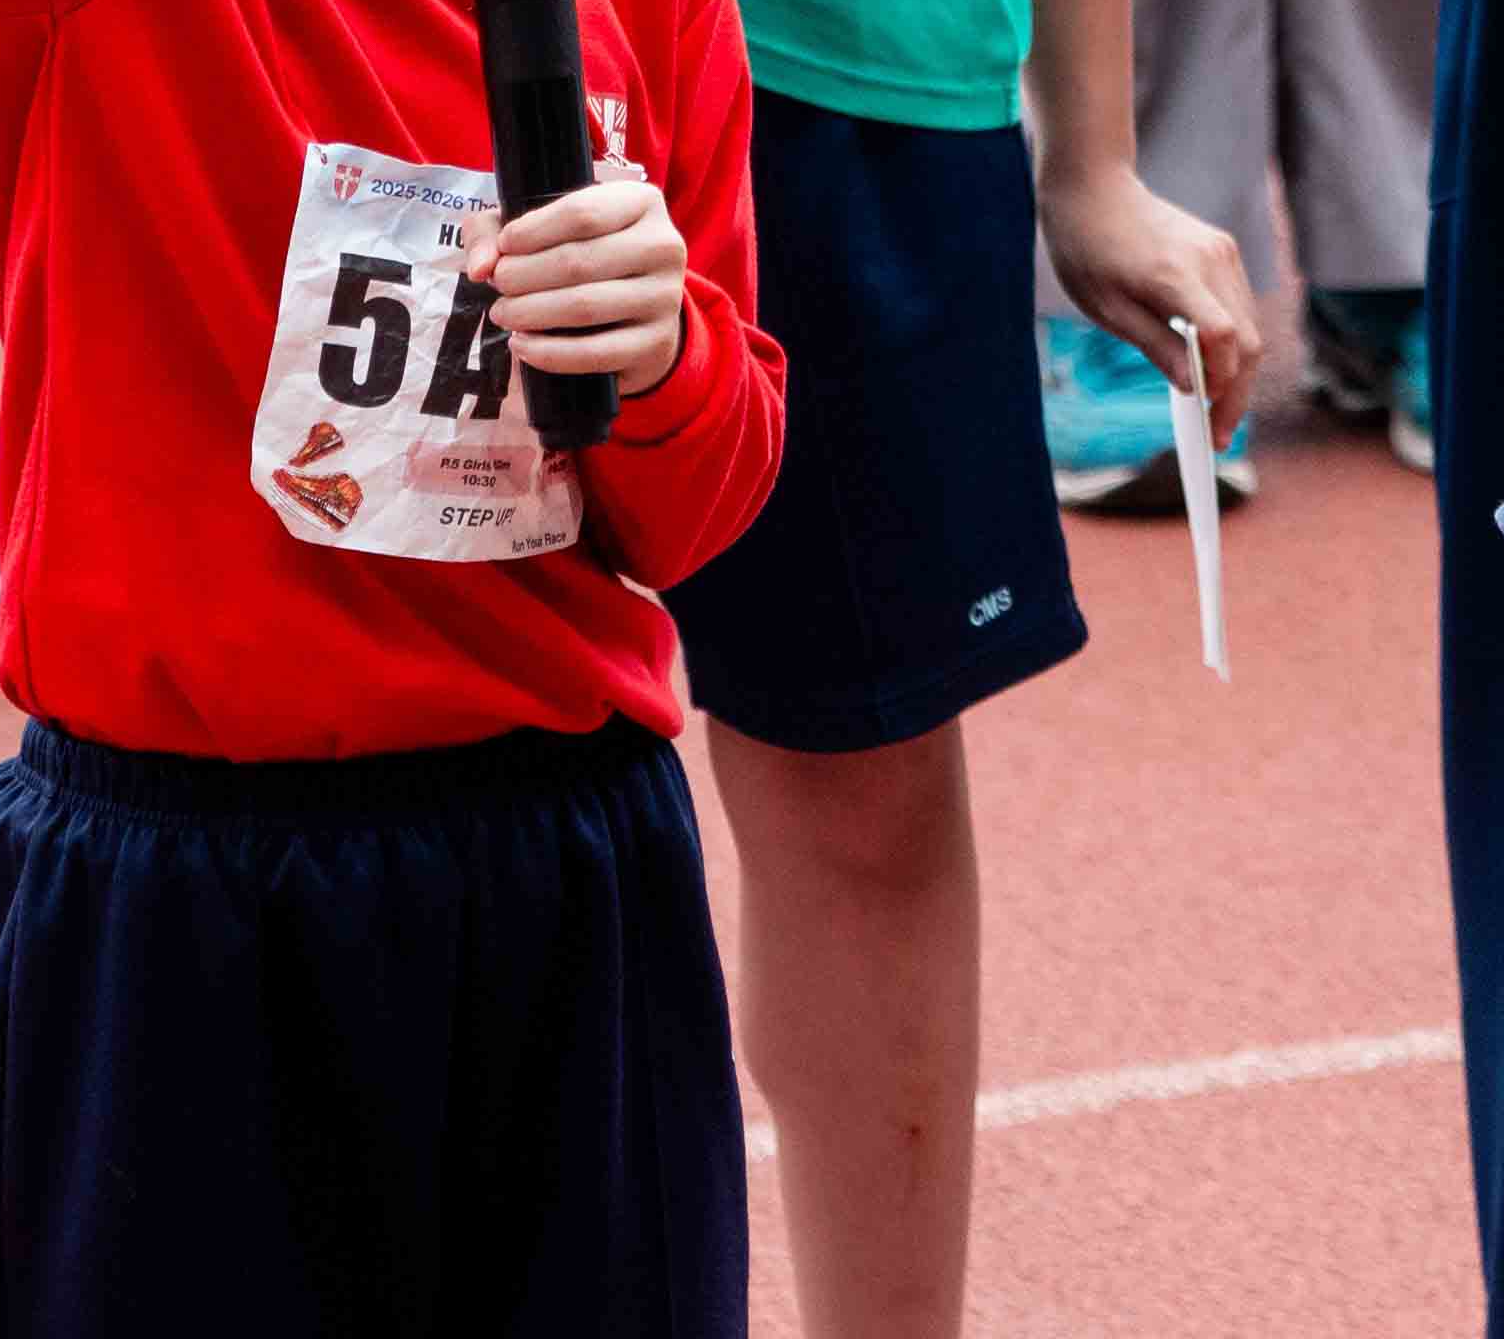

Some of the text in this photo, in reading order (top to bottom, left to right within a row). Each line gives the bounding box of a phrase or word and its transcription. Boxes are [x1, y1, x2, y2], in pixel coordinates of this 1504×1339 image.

[371, 178, 464, 211] 2025-2026
[461, 474, 497, 488] 10:30
[439, 506, 517, 527] STEP UP!
[968, 585, 1013, 627] CMS
